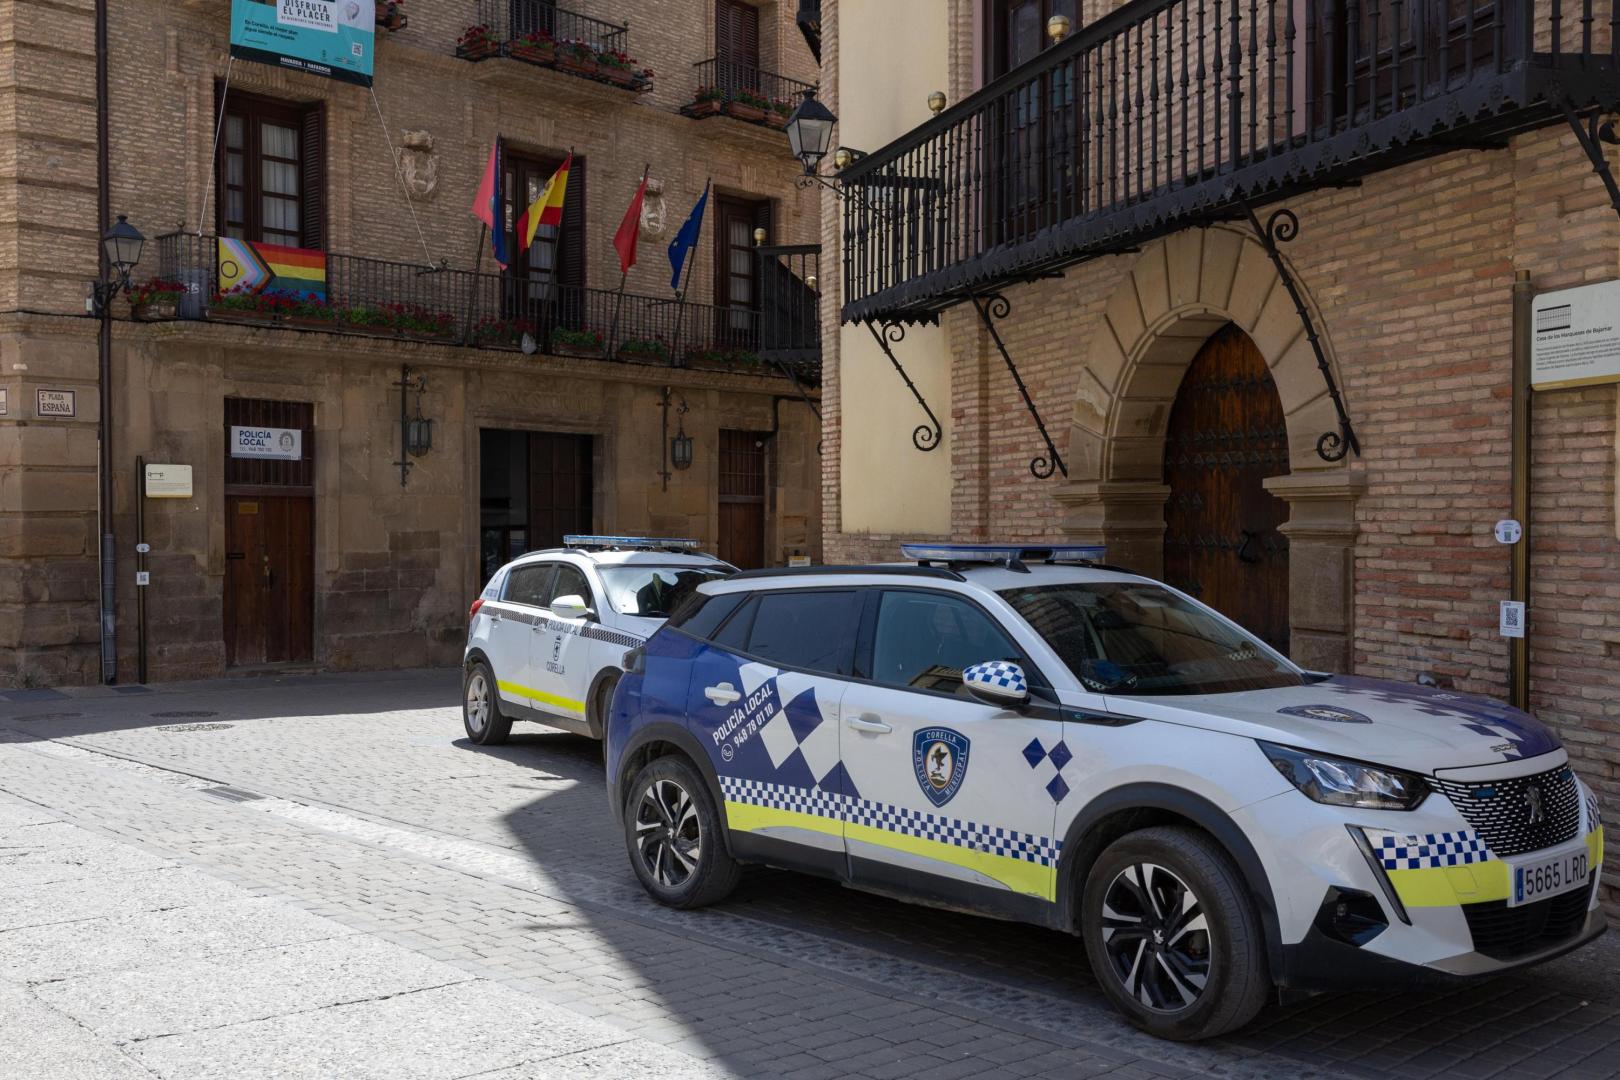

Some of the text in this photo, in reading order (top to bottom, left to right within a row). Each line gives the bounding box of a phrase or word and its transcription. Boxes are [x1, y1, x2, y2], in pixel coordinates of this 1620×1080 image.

[286, 0, 328, 14] DISFRUTA
[283, 6, 330, 22] EL PLACER
[280, 56, 302, 66] NAVARRA
[1561, 330, 1585, 338] Marqueses
[42, 401, 70, 413] ESPAÑA
[239, 430, 272, 439] POLICÍA
[239, 438, 266, 446] LOCAL
[564, 622, 578, 636] LOCAL
[546, 661, 566, 674] CORELLA
[712, 684, 773, 746] POLICÍA LOCAL
[734, 703, 774, 748] 948 78 01 10
[926, 732, 957, 743] CORELLA
[945, 751, 966, 795] MUNICIPAL
[1526, 853, 1587, 896] 5665 LRD
